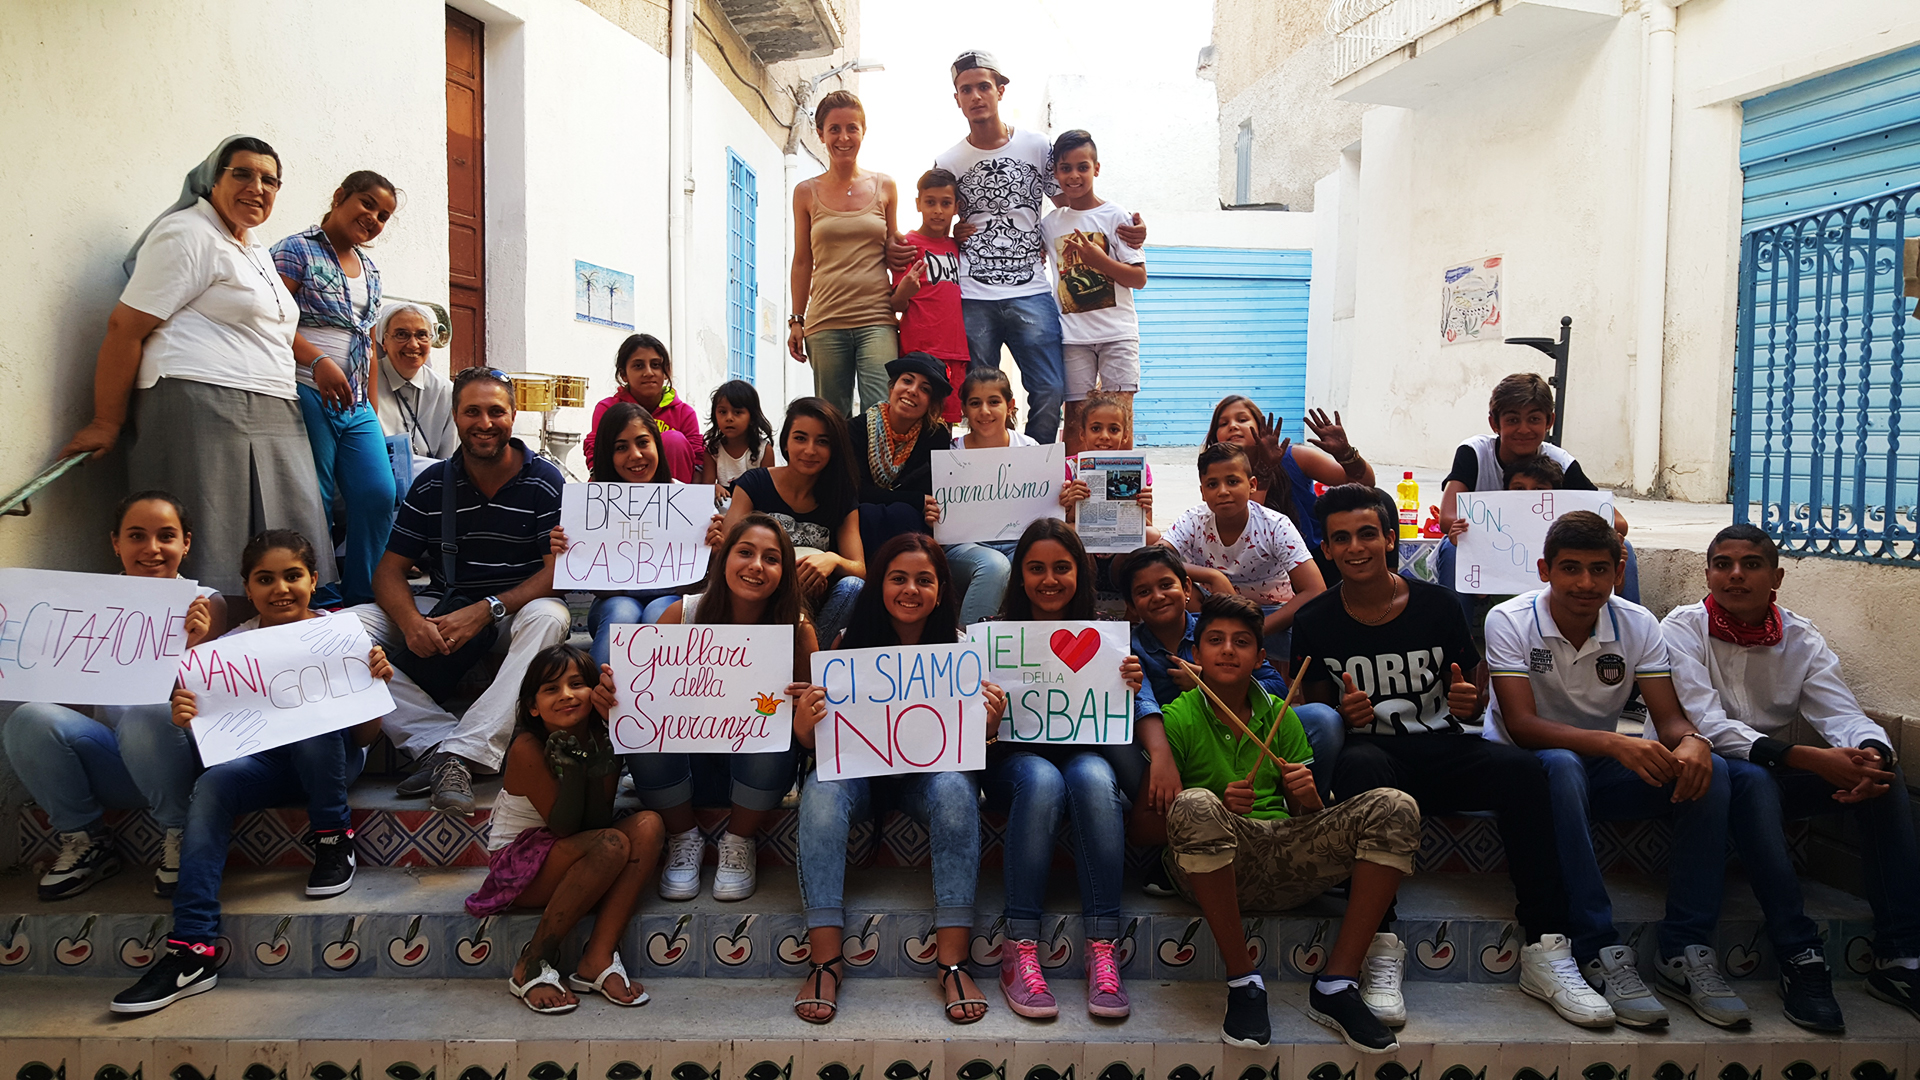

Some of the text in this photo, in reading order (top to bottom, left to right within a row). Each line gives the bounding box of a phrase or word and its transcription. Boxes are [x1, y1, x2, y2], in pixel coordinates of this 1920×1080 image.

[586, 483, 693, 531] BREAK
[935, 463, 1050, 524] giornalismo
[618, 521, 653, 540] THE
[1458, 494, 1541, 579] NON SOL
[566, 541, 697, 584] CASBAH
[178, 649, 374, 709] MANI GOLD
[613, 625, 753, 694] i Giullari
[669, 667, 726, 698] della
[823, 650, 982, 705] CI SIAMO
[1022, 671, 1065, 685] DELLA
[615, 691, 770, 753] Speranza
[834, 699, 963, 774] NOI
[1001, 687, 1130, 742] ASBAH
